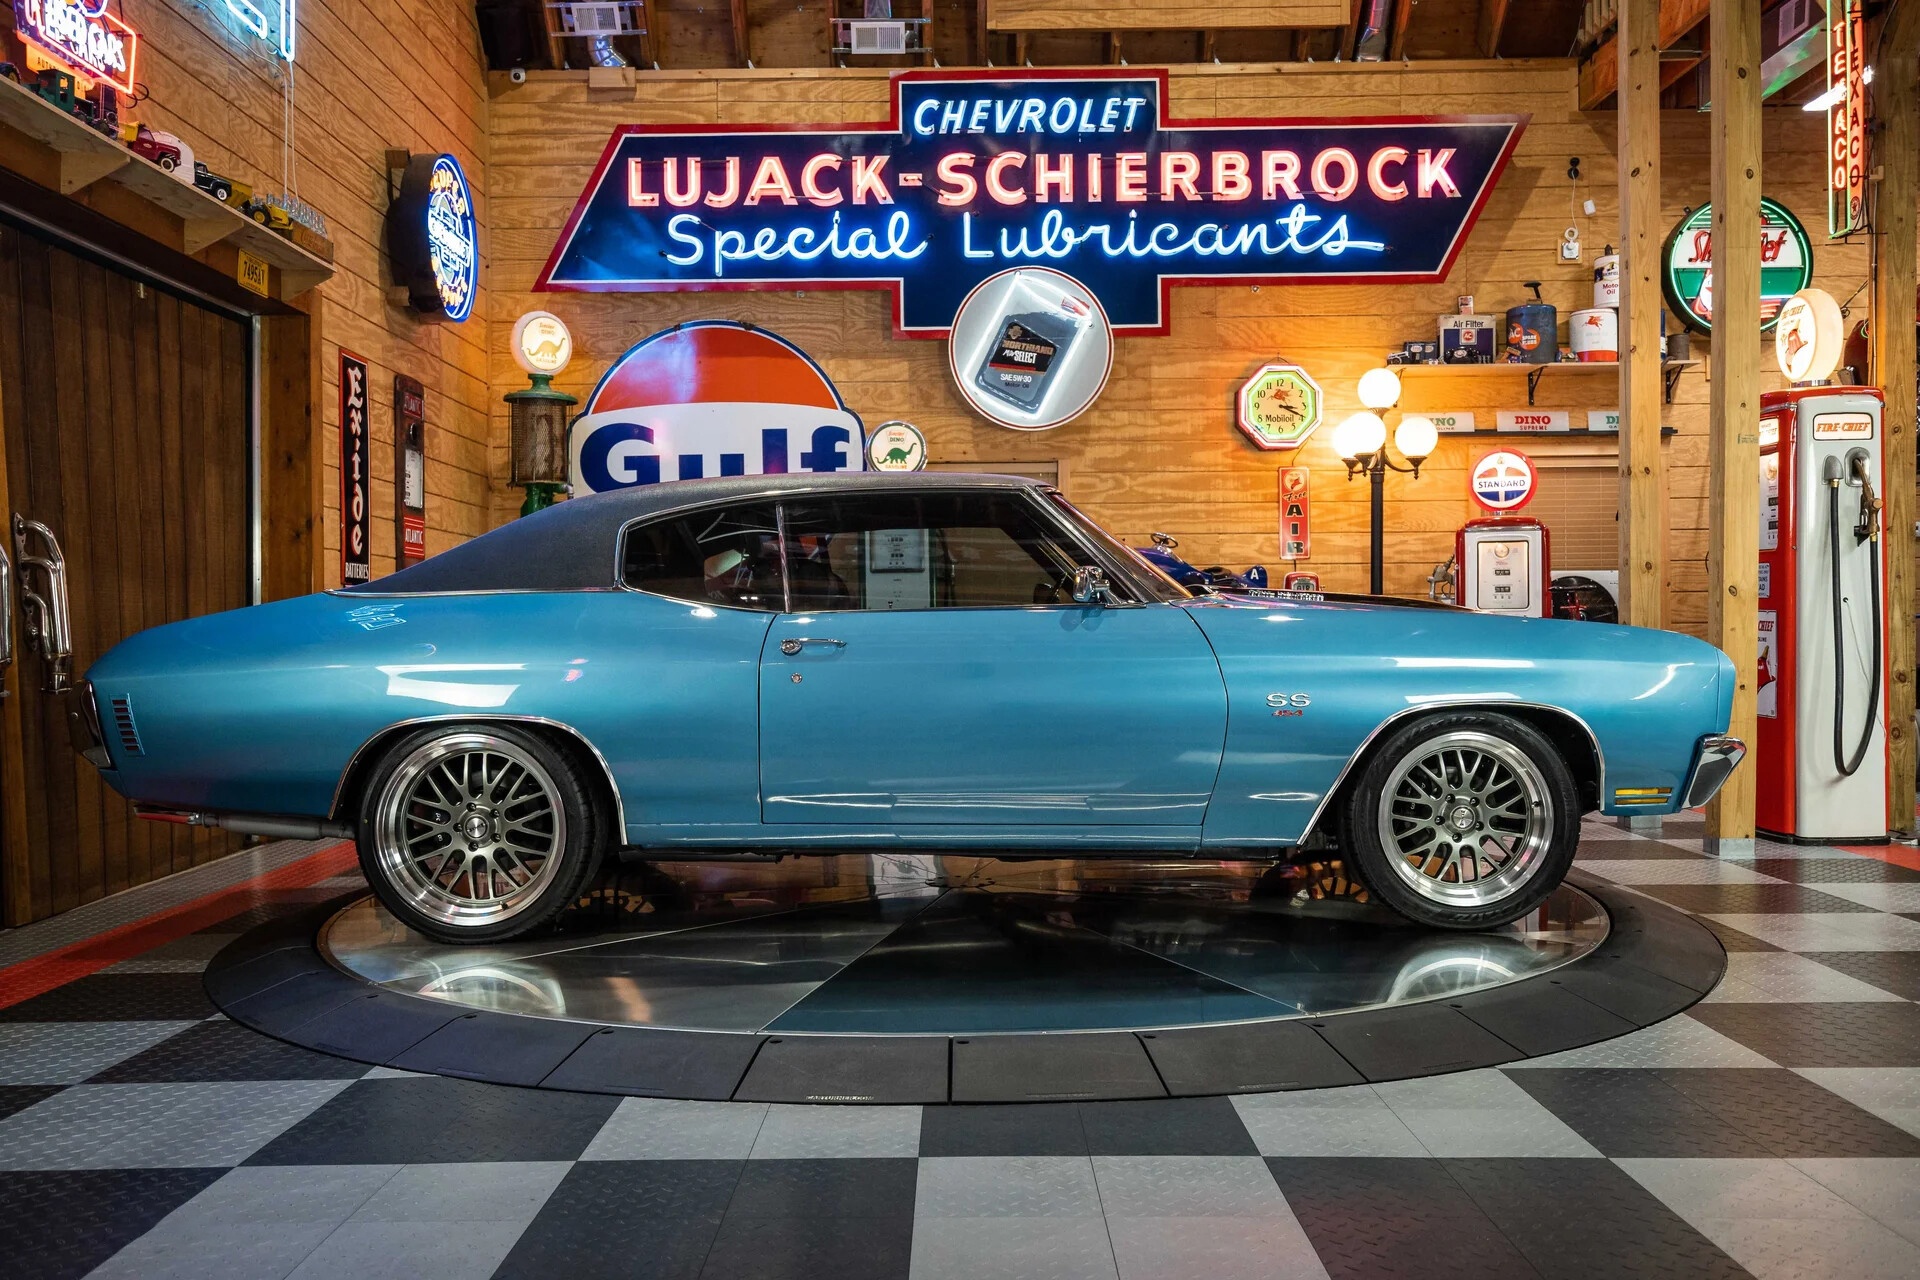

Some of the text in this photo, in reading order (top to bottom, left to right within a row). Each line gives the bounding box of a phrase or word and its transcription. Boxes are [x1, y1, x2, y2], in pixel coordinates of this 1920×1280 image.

[914, 97, 1146, 134] CHEVROLET
[627, 147, 1462, 208] LUJACK-SCHIERBROCK
[660, 204, 1388, 276] Special Lubricants
[1510, 327, 1521, 338] AC
[1013, 375, 1032, 383] 5W-30
[1276, 379, 1284, 387] 12
[1257, 390, 1266, 398] 10
[1299, 390, 1303, 398] 2
[1254, 402, 1260, 411] 9
[1302, 402, 1307, 410] 3
[1429, 417, 1456, 426] INO
[1515, 415, 1551, 425] DINO
[1605, 416, 1619, 424] DI
[347, 366, 364, 556] Exide
[1478, 480, 1526, 489] STANDARD
[1286, 504, 1304, 554] AIR
[405, 528, 423, 545] ATLANTIC
[345, 562, 369, 579] BATTERIES
[1250, 568, 1260, 581] A
[1265, 692, 1312, 708] SS
[1272, 709, 1304, 717] 454
